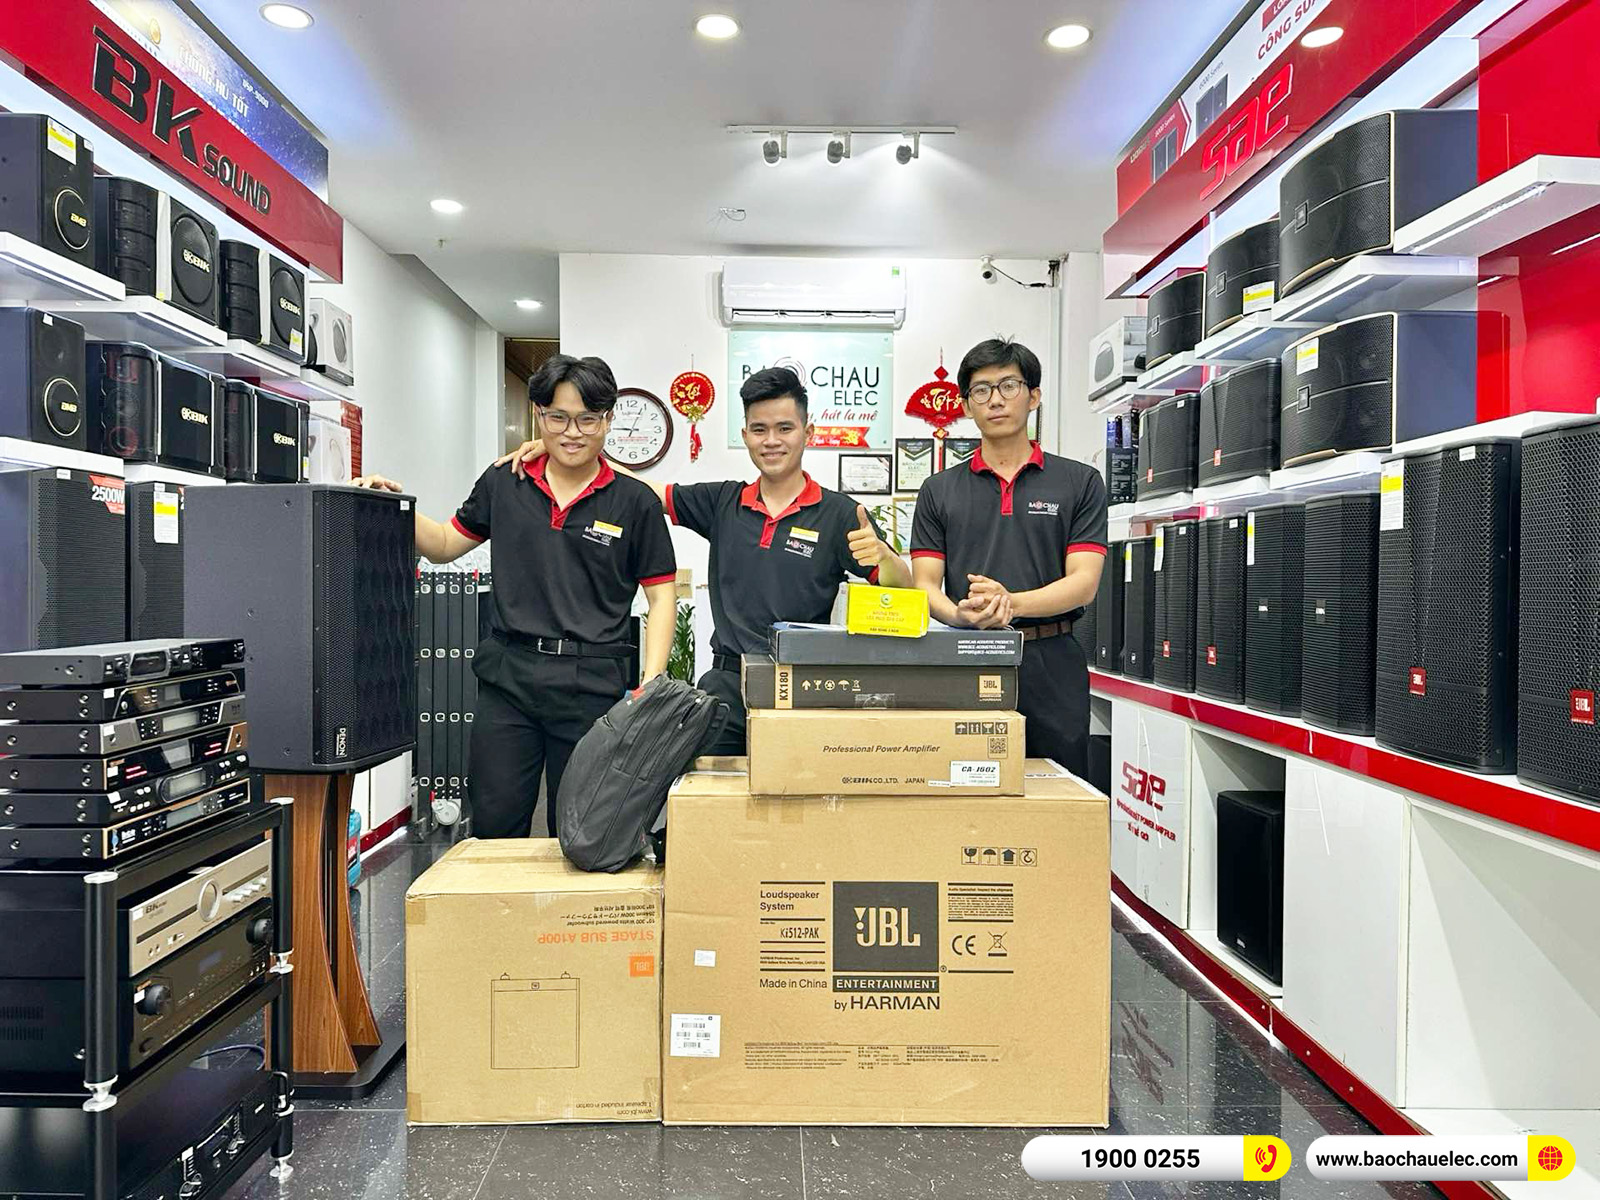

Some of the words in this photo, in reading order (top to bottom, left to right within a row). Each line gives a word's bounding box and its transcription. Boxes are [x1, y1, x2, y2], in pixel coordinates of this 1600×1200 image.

[1257, 17, 1292, 60] CÔNG
[232, 93, 249, 118] TỐT
[92, 24, 203, 168] BK
[202, 142, 271, 215] SOUND
[70, 213, 87, 228] BMB
[811, 366, 880, 388] CHAU
[626, 400, 639, 408] 12
[834, 390, 878, 406] ELEC
[61, 401, 78, 413] BMB
[649, 413, 658, 421] 2
[821, 408, 842, 421] hát
[858, 409, 878, 421] mê
[653, 426, 662, 434] 3
[607, 438, 616, 446] 8
[617, 446, 625, 455] 7
[628, 451, 638, 460] 6
[91, 485, 125, 503] 2500W
[779, 671, 789, 701] KX180
[983, 680, 998, 689] JBL
[1575, 697, 1591, 711] JBL
[339, 727, 347, 756] DENON
[823, 745, 874, 753] Professional
[875, 745, 902, 753] Power
[902, 744, 940, 753] Amplifier
[760, 890, 820, 900] Loudspeaker
[760, 902, 795, 912] System
[780, 927, 820, 939] Ki512-PAK
[853, 907, 922, 947] JBL
[538, 933, 576, 944] A100P
[581, 932, 607, 943] SUB
[611, 930, 654, 942] STAGE
[760, 979, 787, 988] Made
[789, 979, 797, 988] in
[799, 979, 828, 988] China
[836, 979, 937, 989] ENTERTAINMENT
[834, 1000, 848, 1012] by
[850, 996, 940, 1010] HARMAN
